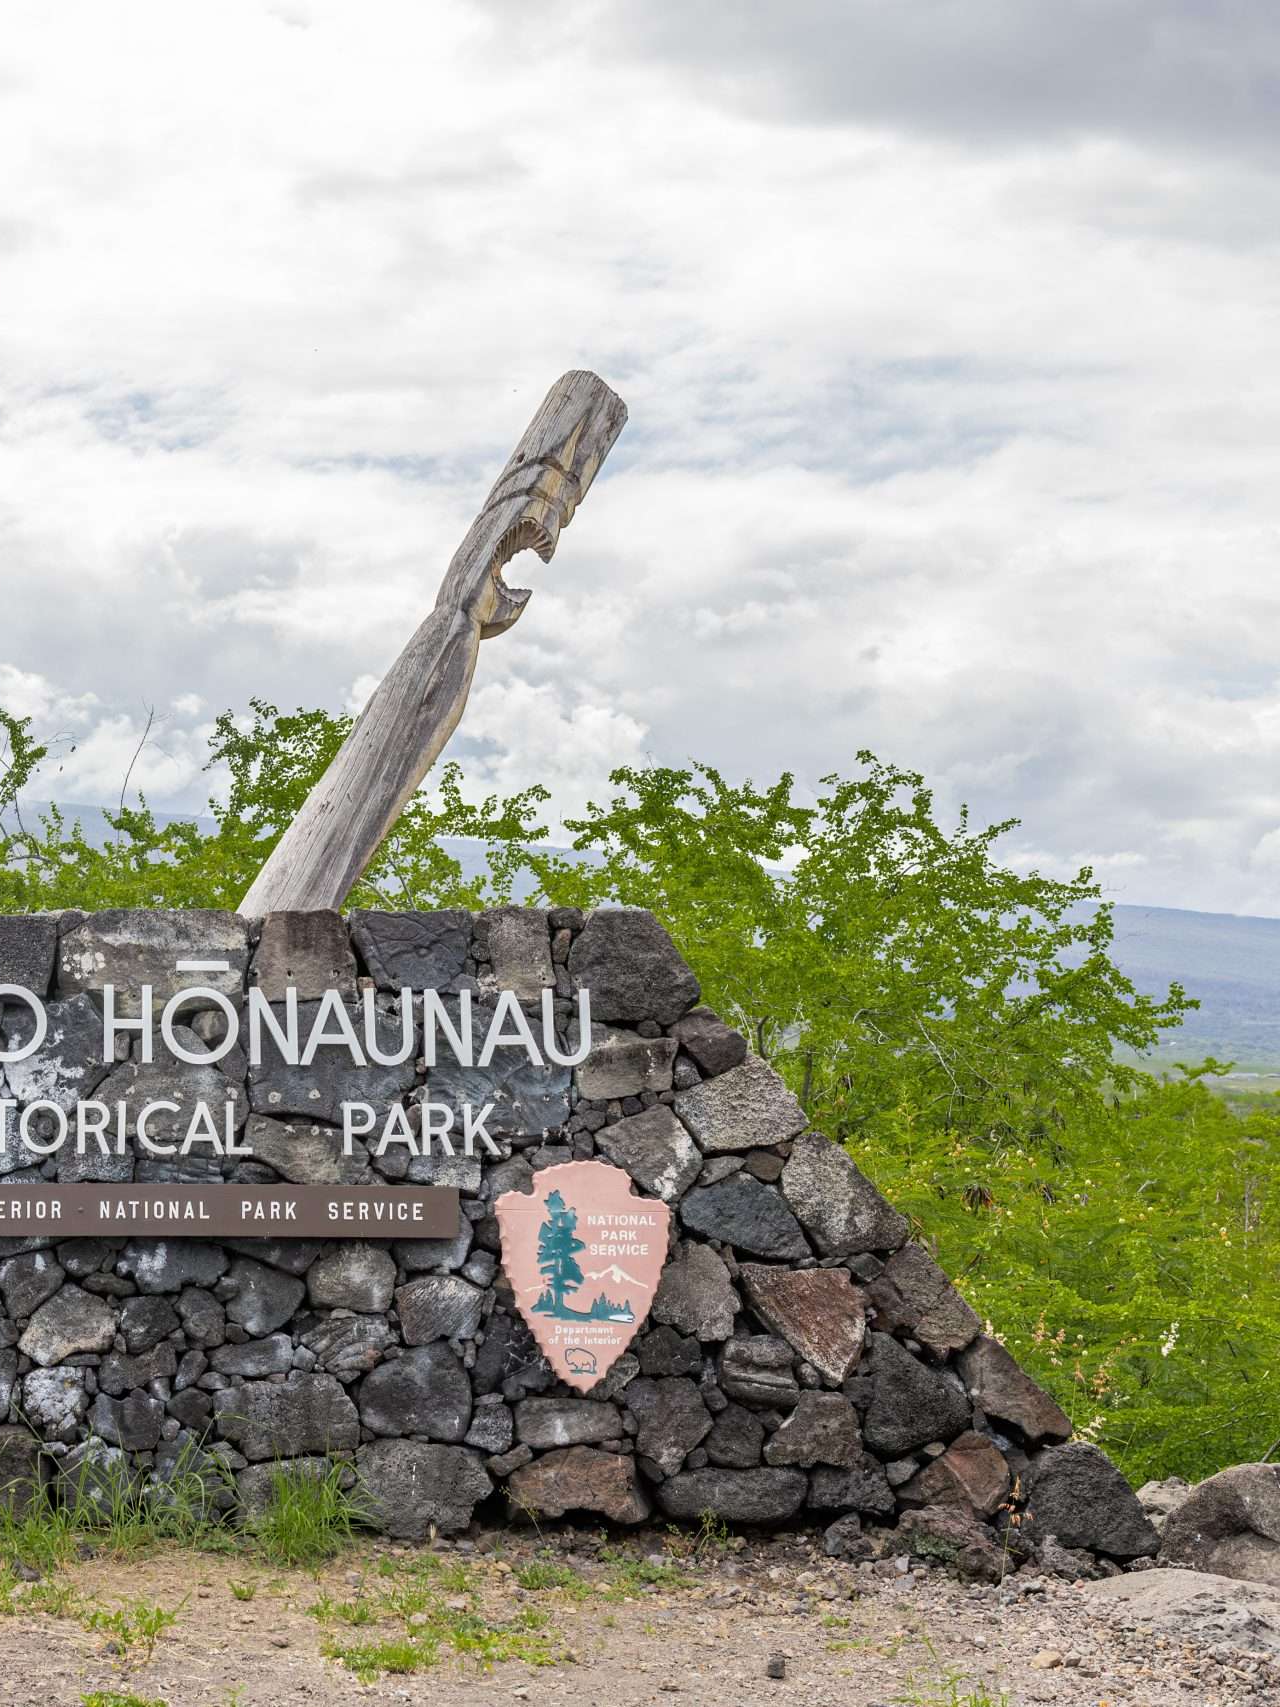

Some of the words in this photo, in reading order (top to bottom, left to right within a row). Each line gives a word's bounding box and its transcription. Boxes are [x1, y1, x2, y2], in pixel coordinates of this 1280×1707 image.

[103, 960, 592, 1067] HŌNAUNAU
[342, 1101, 502, 1157] PARK
[99, 1200, 211, 1222] NATIONAL
[240, 1200, 298, 1222] PARK
[327, 1201, 425, 1223] SERVICE
[587, 1215, 656, 1227] NATIONAL
[601, 1230, 638, 1241] PARK
[589, 1244, 649, 1256] SERVICE
[554, 1325, 614, 1336] Department
[548, 1335, 559, 1345] of
[564, 1335, 581, 1345] the
[584, 1335, 622, 1345] Interior
